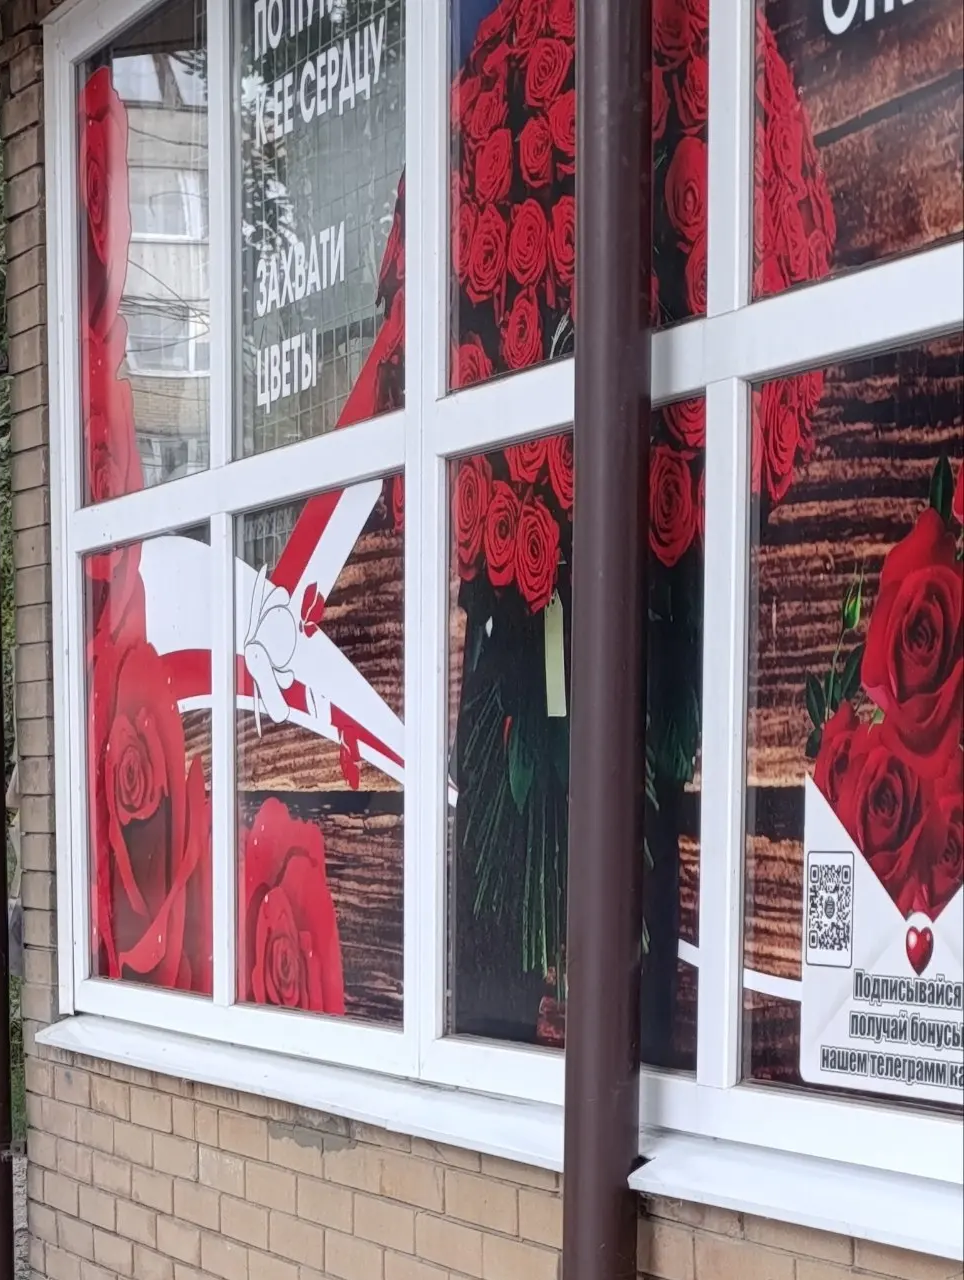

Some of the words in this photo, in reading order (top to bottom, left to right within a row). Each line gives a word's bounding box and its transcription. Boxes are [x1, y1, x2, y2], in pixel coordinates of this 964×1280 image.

[254, 0, 283, 60] ПО
[255, 83, 267, 149] К
[274, 72, 294, 139] ЕЕ
[300, 15, 385, 123] СЕРДЦУ
[256, 221, 345, 317] ЗАХВАТИ
[256, 328, 316, 414] ЦВЕТЫ
[854, 970, 962, 1009] Подписывайся
[850, 1012, 908, 1042] получай
[910, 1015, 964, 1050] бонусы
[821, 1047, 867, 1074] нашем
[869, 1053, 947, 1085] телеграмм
